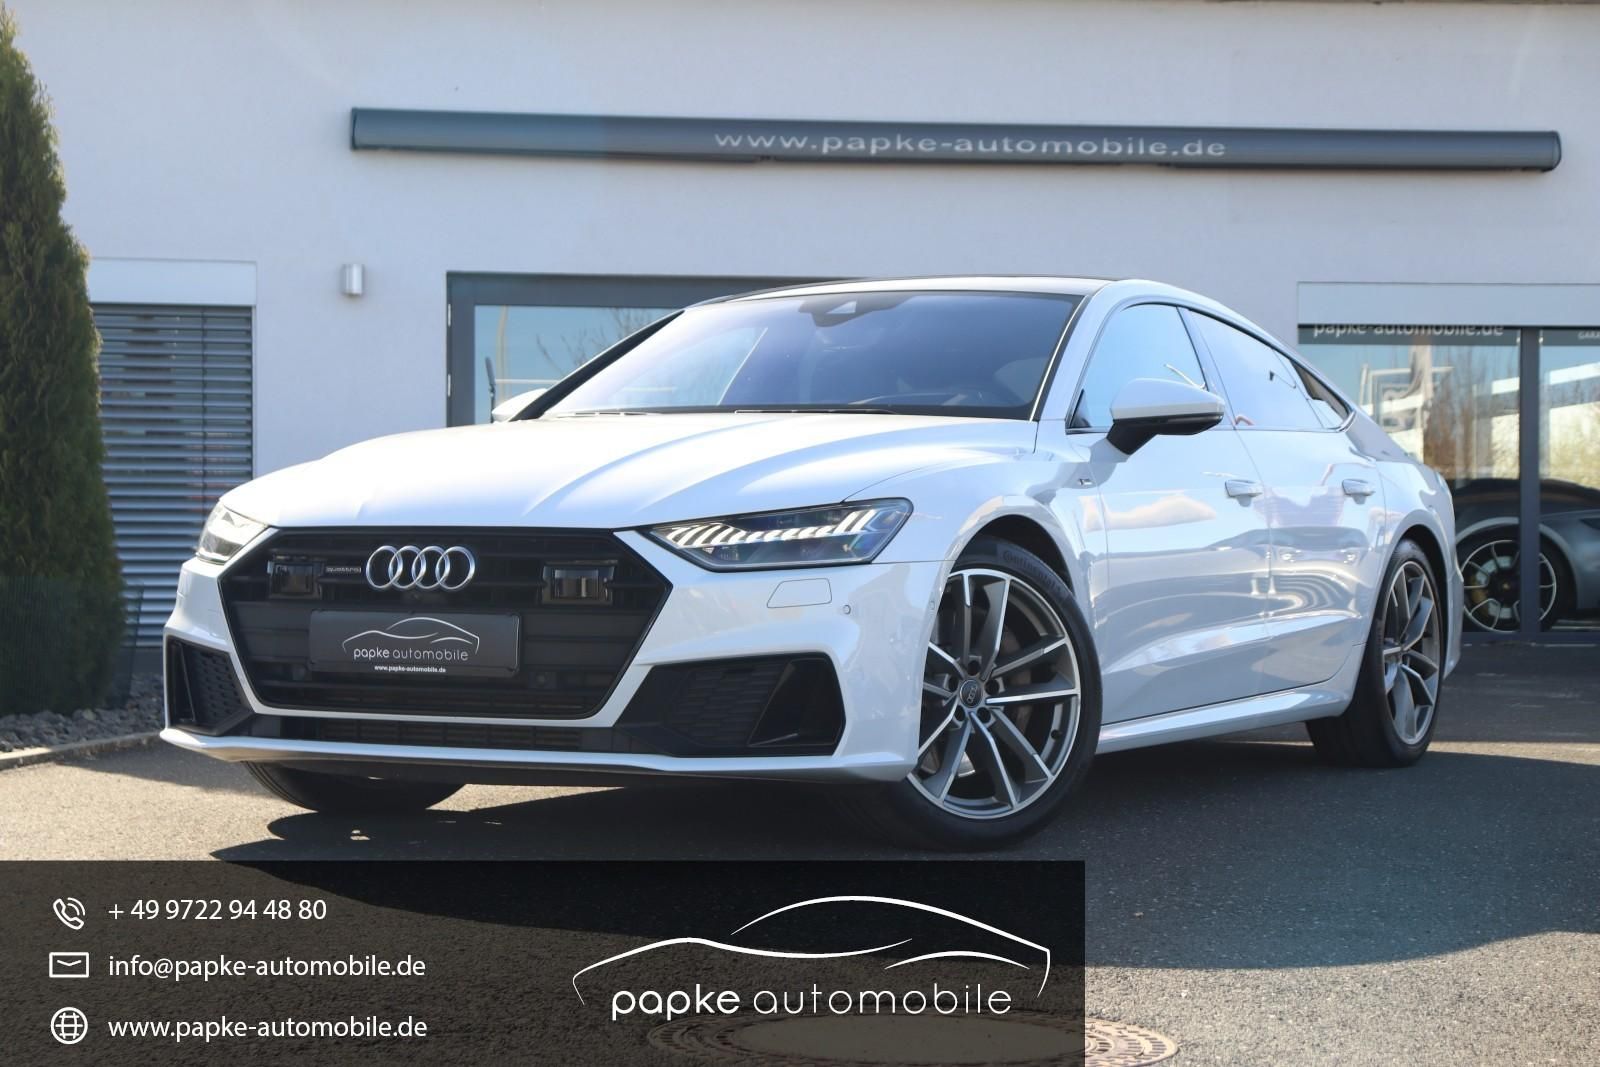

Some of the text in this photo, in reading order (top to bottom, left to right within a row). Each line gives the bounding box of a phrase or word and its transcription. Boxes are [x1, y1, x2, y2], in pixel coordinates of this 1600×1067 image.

[714, 130, 1227, 159] www.papke-automobile.de
[353, 647, 469, 662] papke automobile
[374, 664, 447, 673] www.papke-automobile.de
